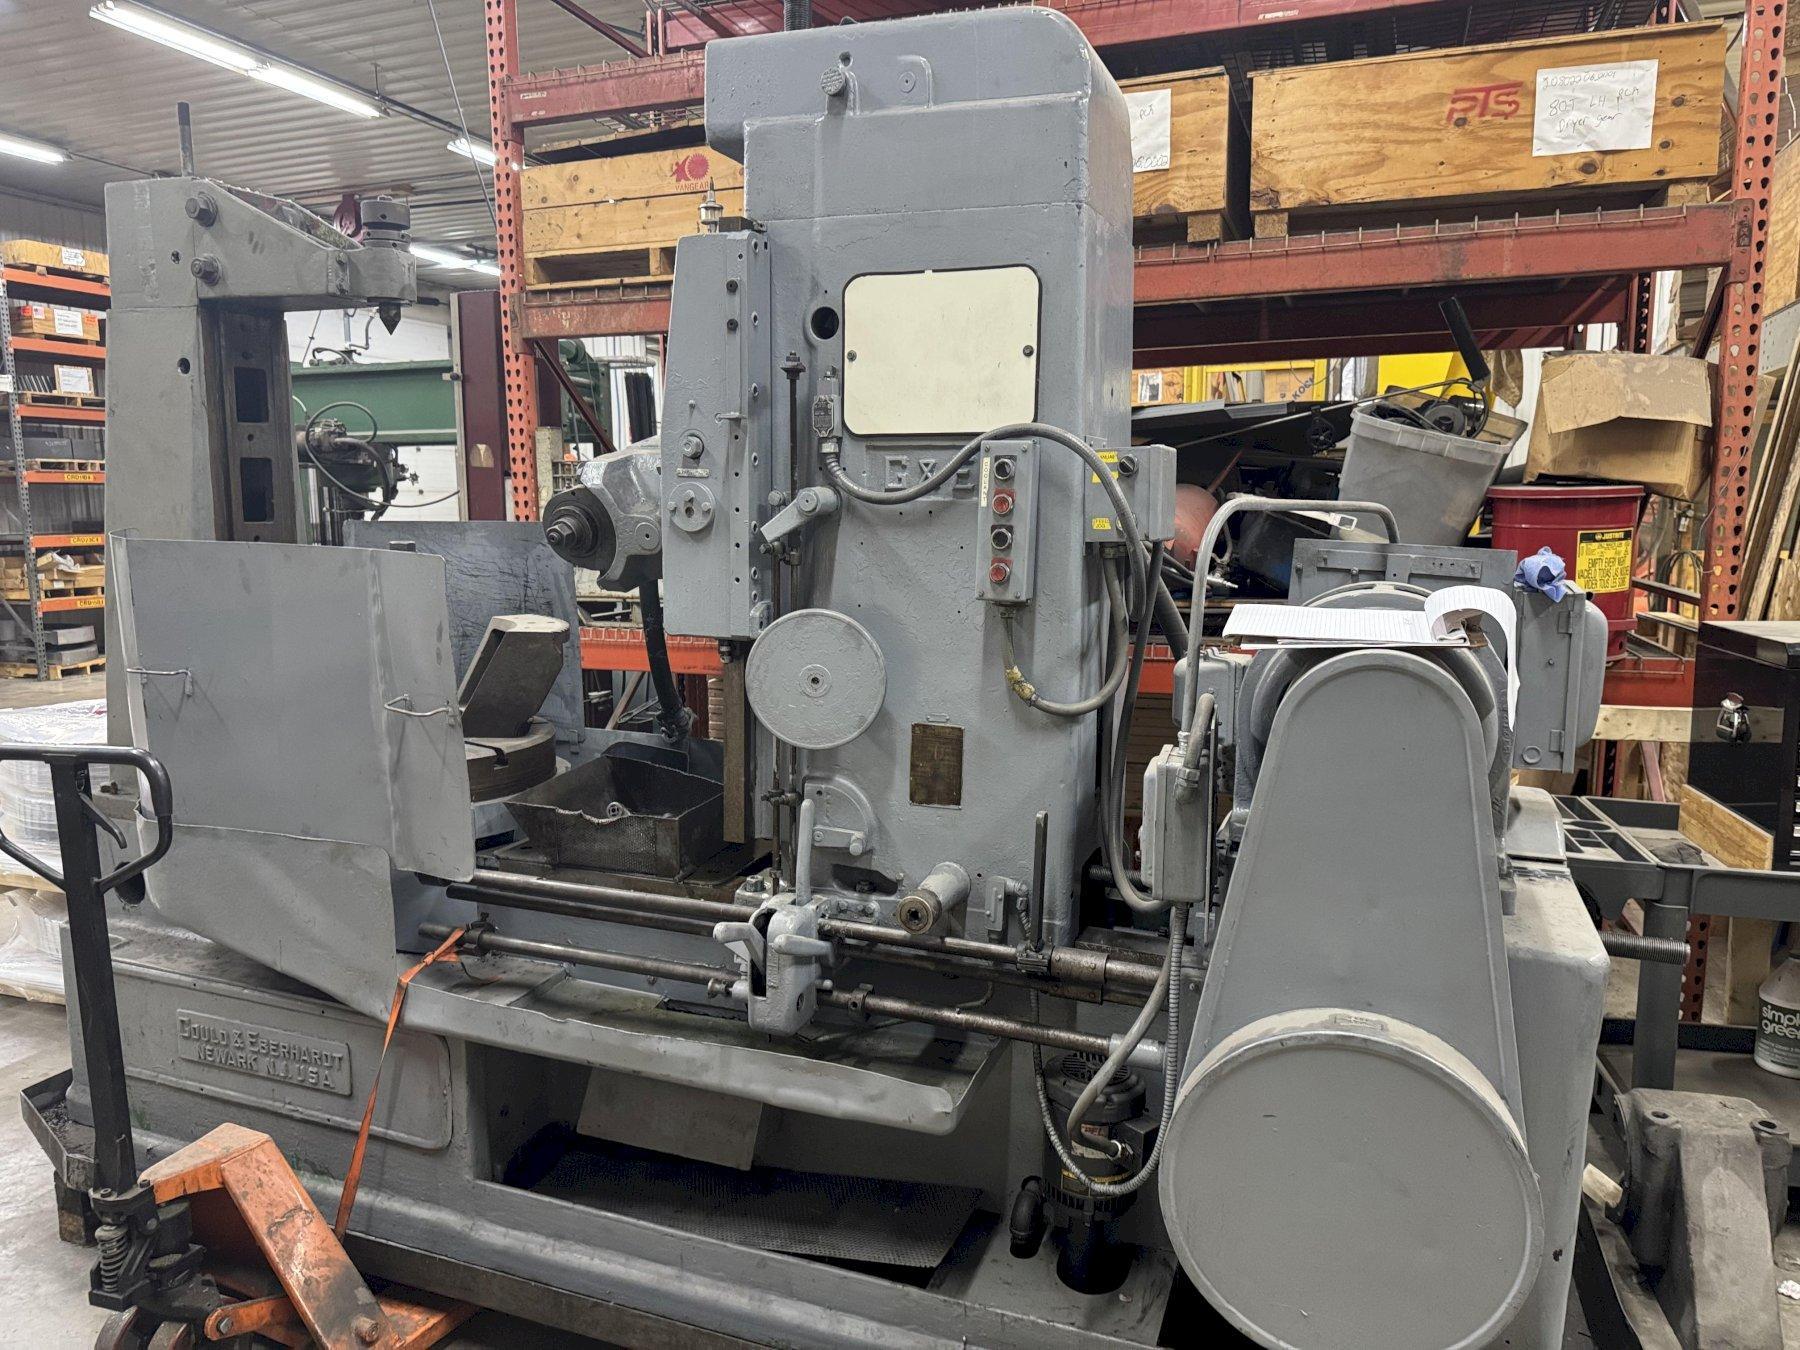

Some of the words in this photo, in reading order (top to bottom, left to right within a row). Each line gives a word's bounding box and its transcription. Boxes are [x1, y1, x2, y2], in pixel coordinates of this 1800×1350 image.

[1445, 80, 1525, 125] PTS
[1588, 557, 1603, 568] EMPTY
[1604, 556, 1617, 568] EVERY
[177, 1016, 229, 1046] GOULD
[232, 1029, 245, 1048] &
[248, 1031, 344, 1071] EBERHARDT
[196, 1044, 260, 1071] NEWARK
